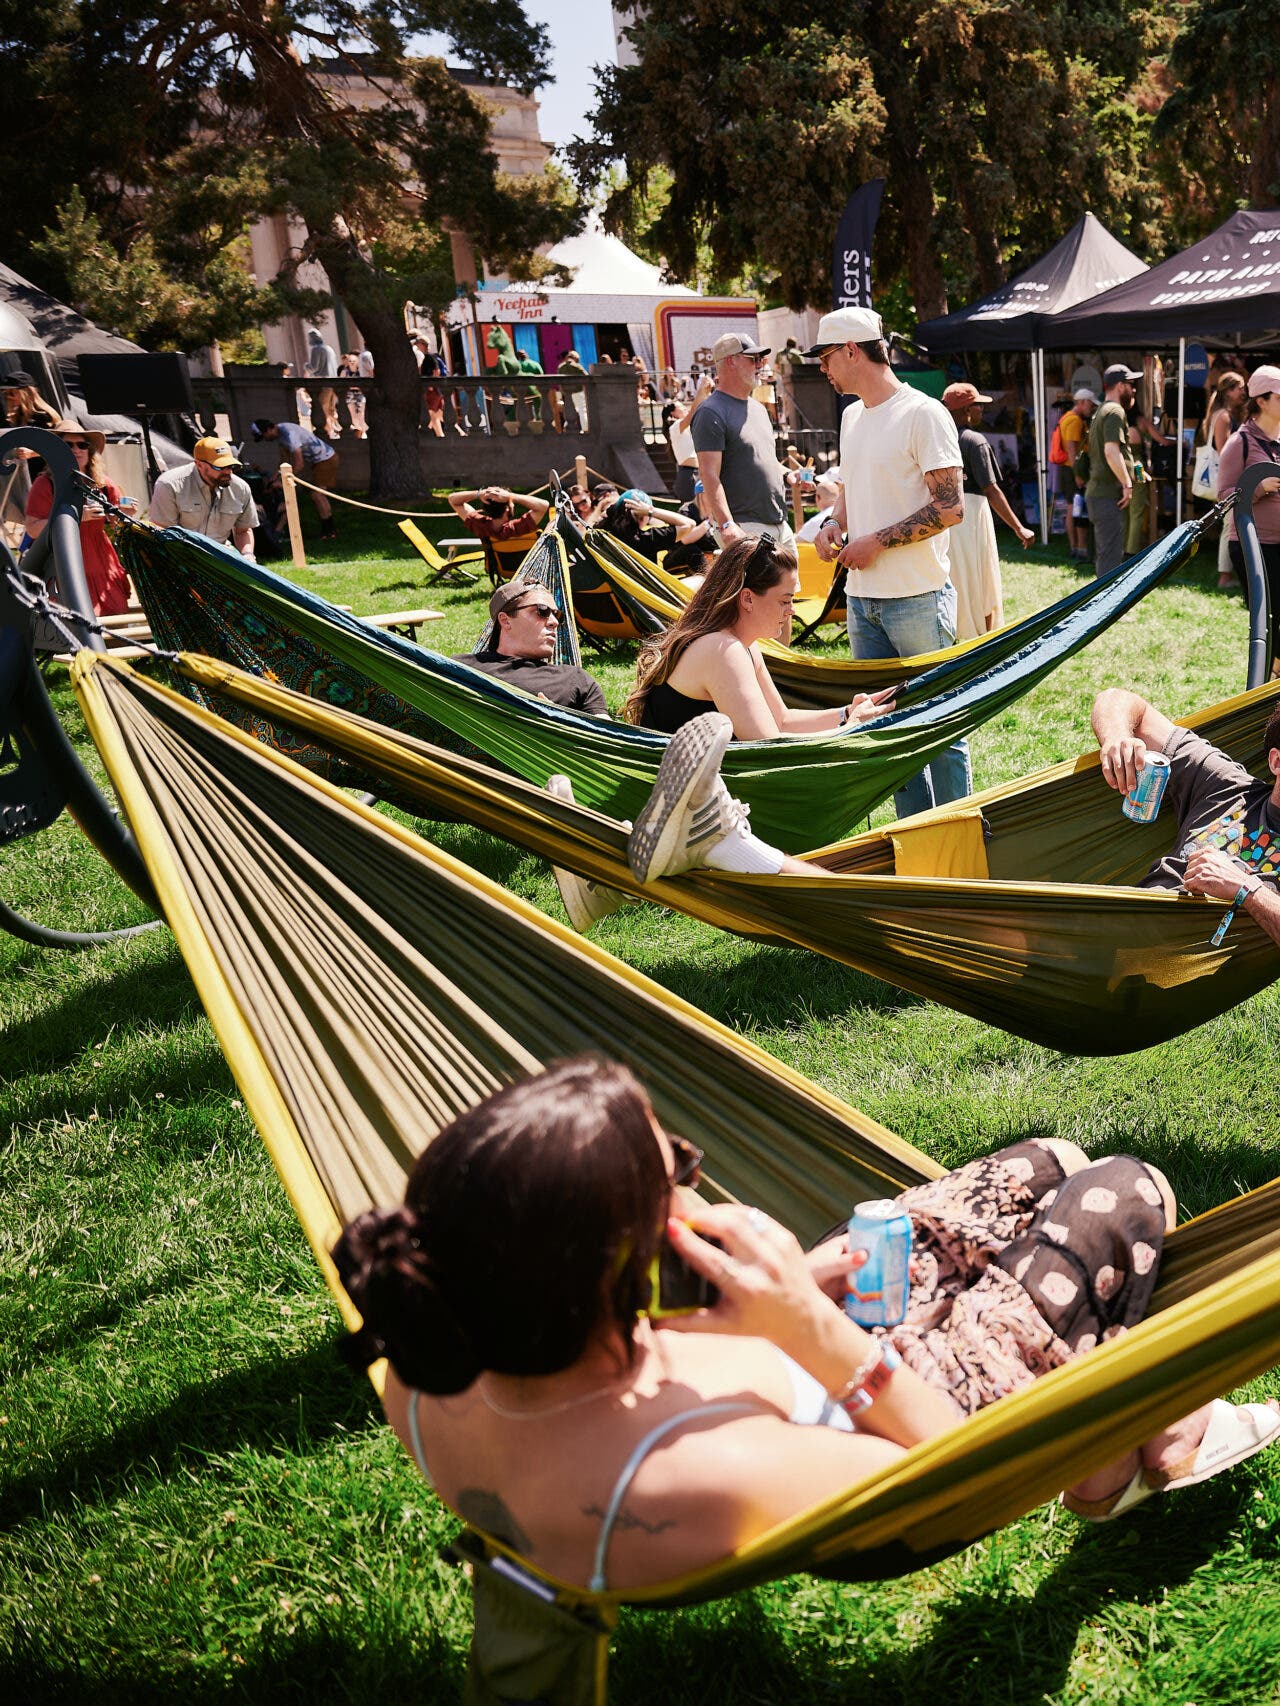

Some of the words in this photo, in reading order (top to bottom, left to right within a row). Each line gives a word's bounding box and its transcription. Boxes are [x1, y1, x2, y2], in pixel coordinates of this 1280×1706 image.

[1249, 228, 1280, 245] REI
[1168, 268, 1233, 285] PATH
[1150, 281, 1271, 305] VENTURES
[518, 308, 543, 320] Inn
